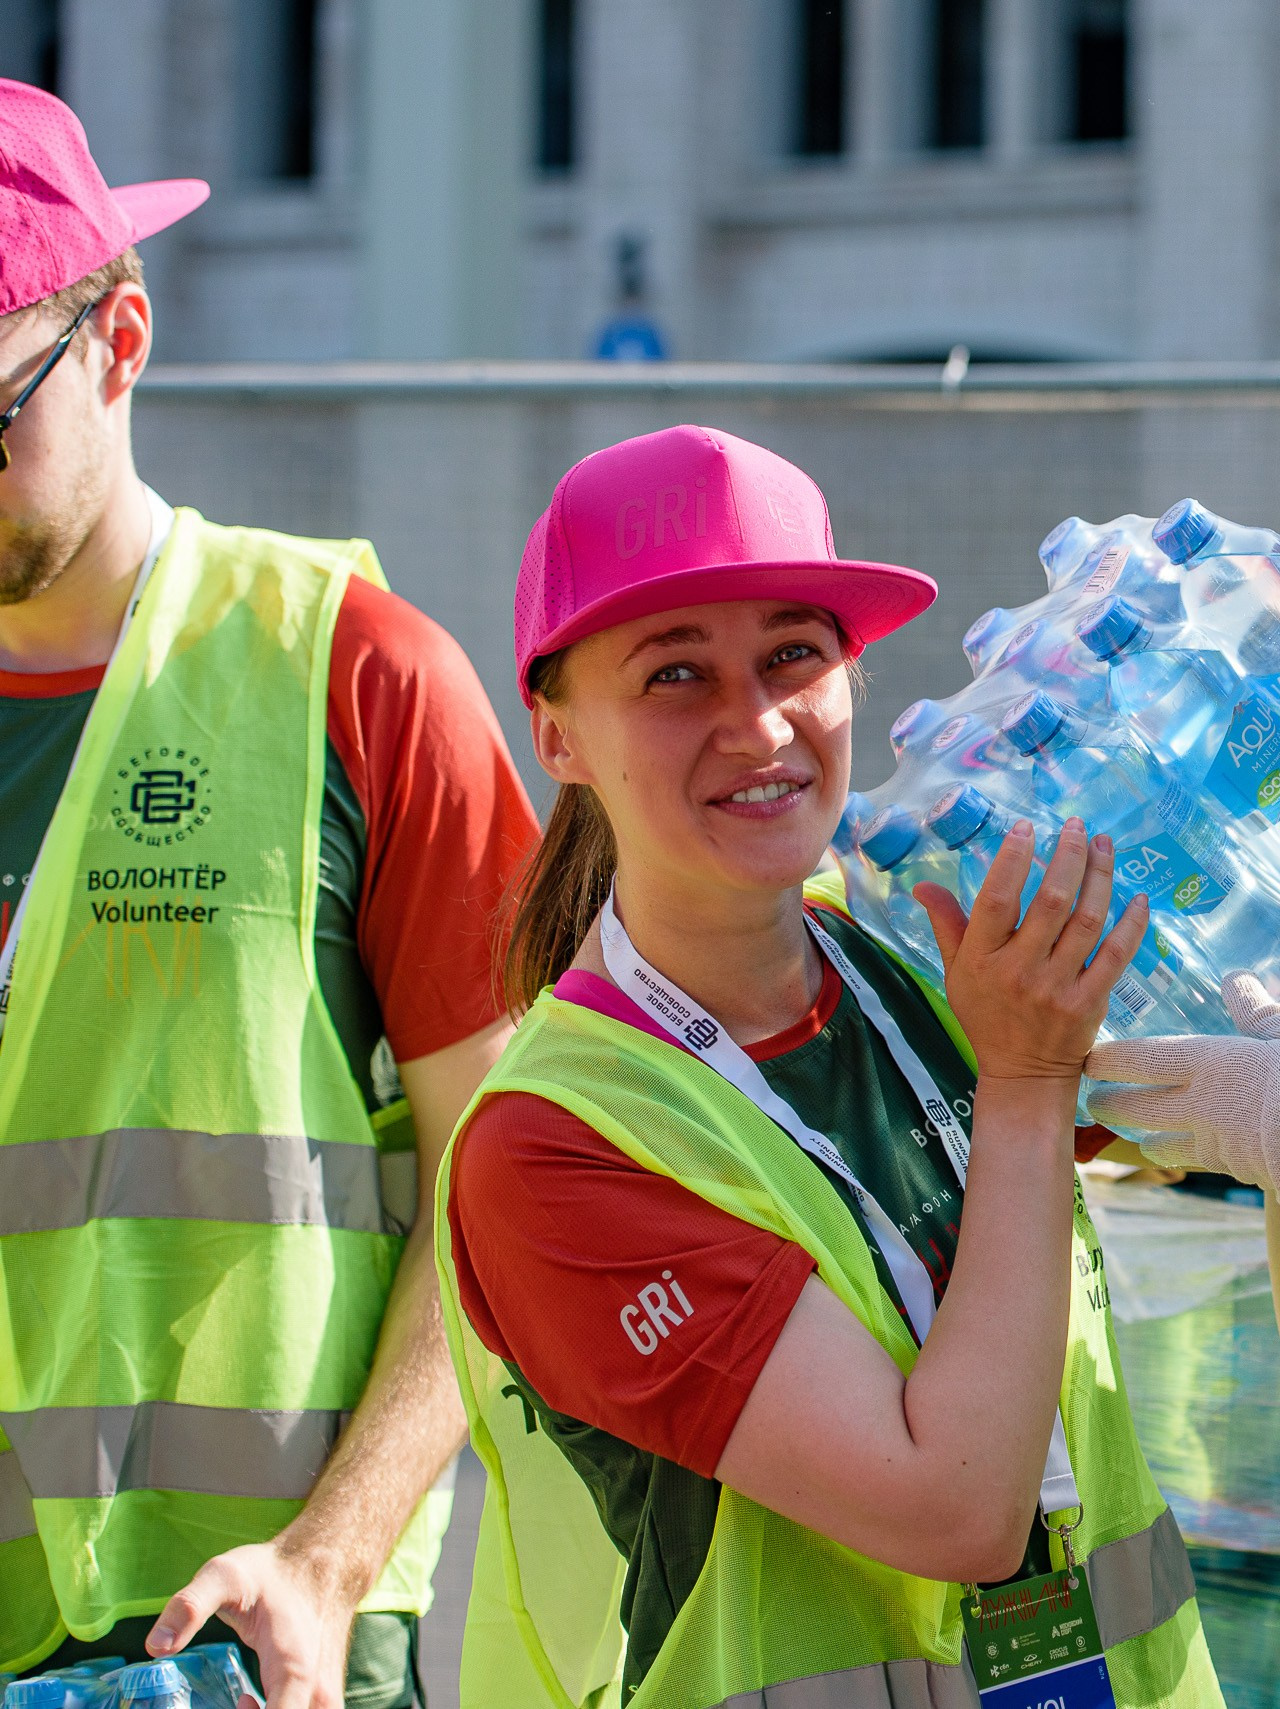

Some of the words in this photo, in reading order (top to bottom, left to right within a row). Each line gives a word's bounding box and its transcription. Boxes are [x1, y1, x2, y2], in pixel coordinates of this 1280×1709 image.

[614, 476, 708, 560] GRi
[117, 747, 210, 778] БЕГОВОЕ
[111, 805, 211, 847] СООБЩЕСТВО
[87, 864, 227, 891] ВОЛОНТЁР
[1113, 846, 1168, 886] КВА
[1175, 874, 1208, 903] 100%
[92, 900, 221, 924] Volunteer
[634, 968, 691, 1019] СООБЩЕСТВО
[646, 993, 684, 1027] БЕГОВОЕ
[809, 1137, 844, 1163] MUNITY
[946, 1131, 968, 1173] COMMUN
[952, 1130, 969, 1161] RUNNI
[819, 1149, 856, 1178] UNNING
[620, 1269, 694, 1355] GRi
